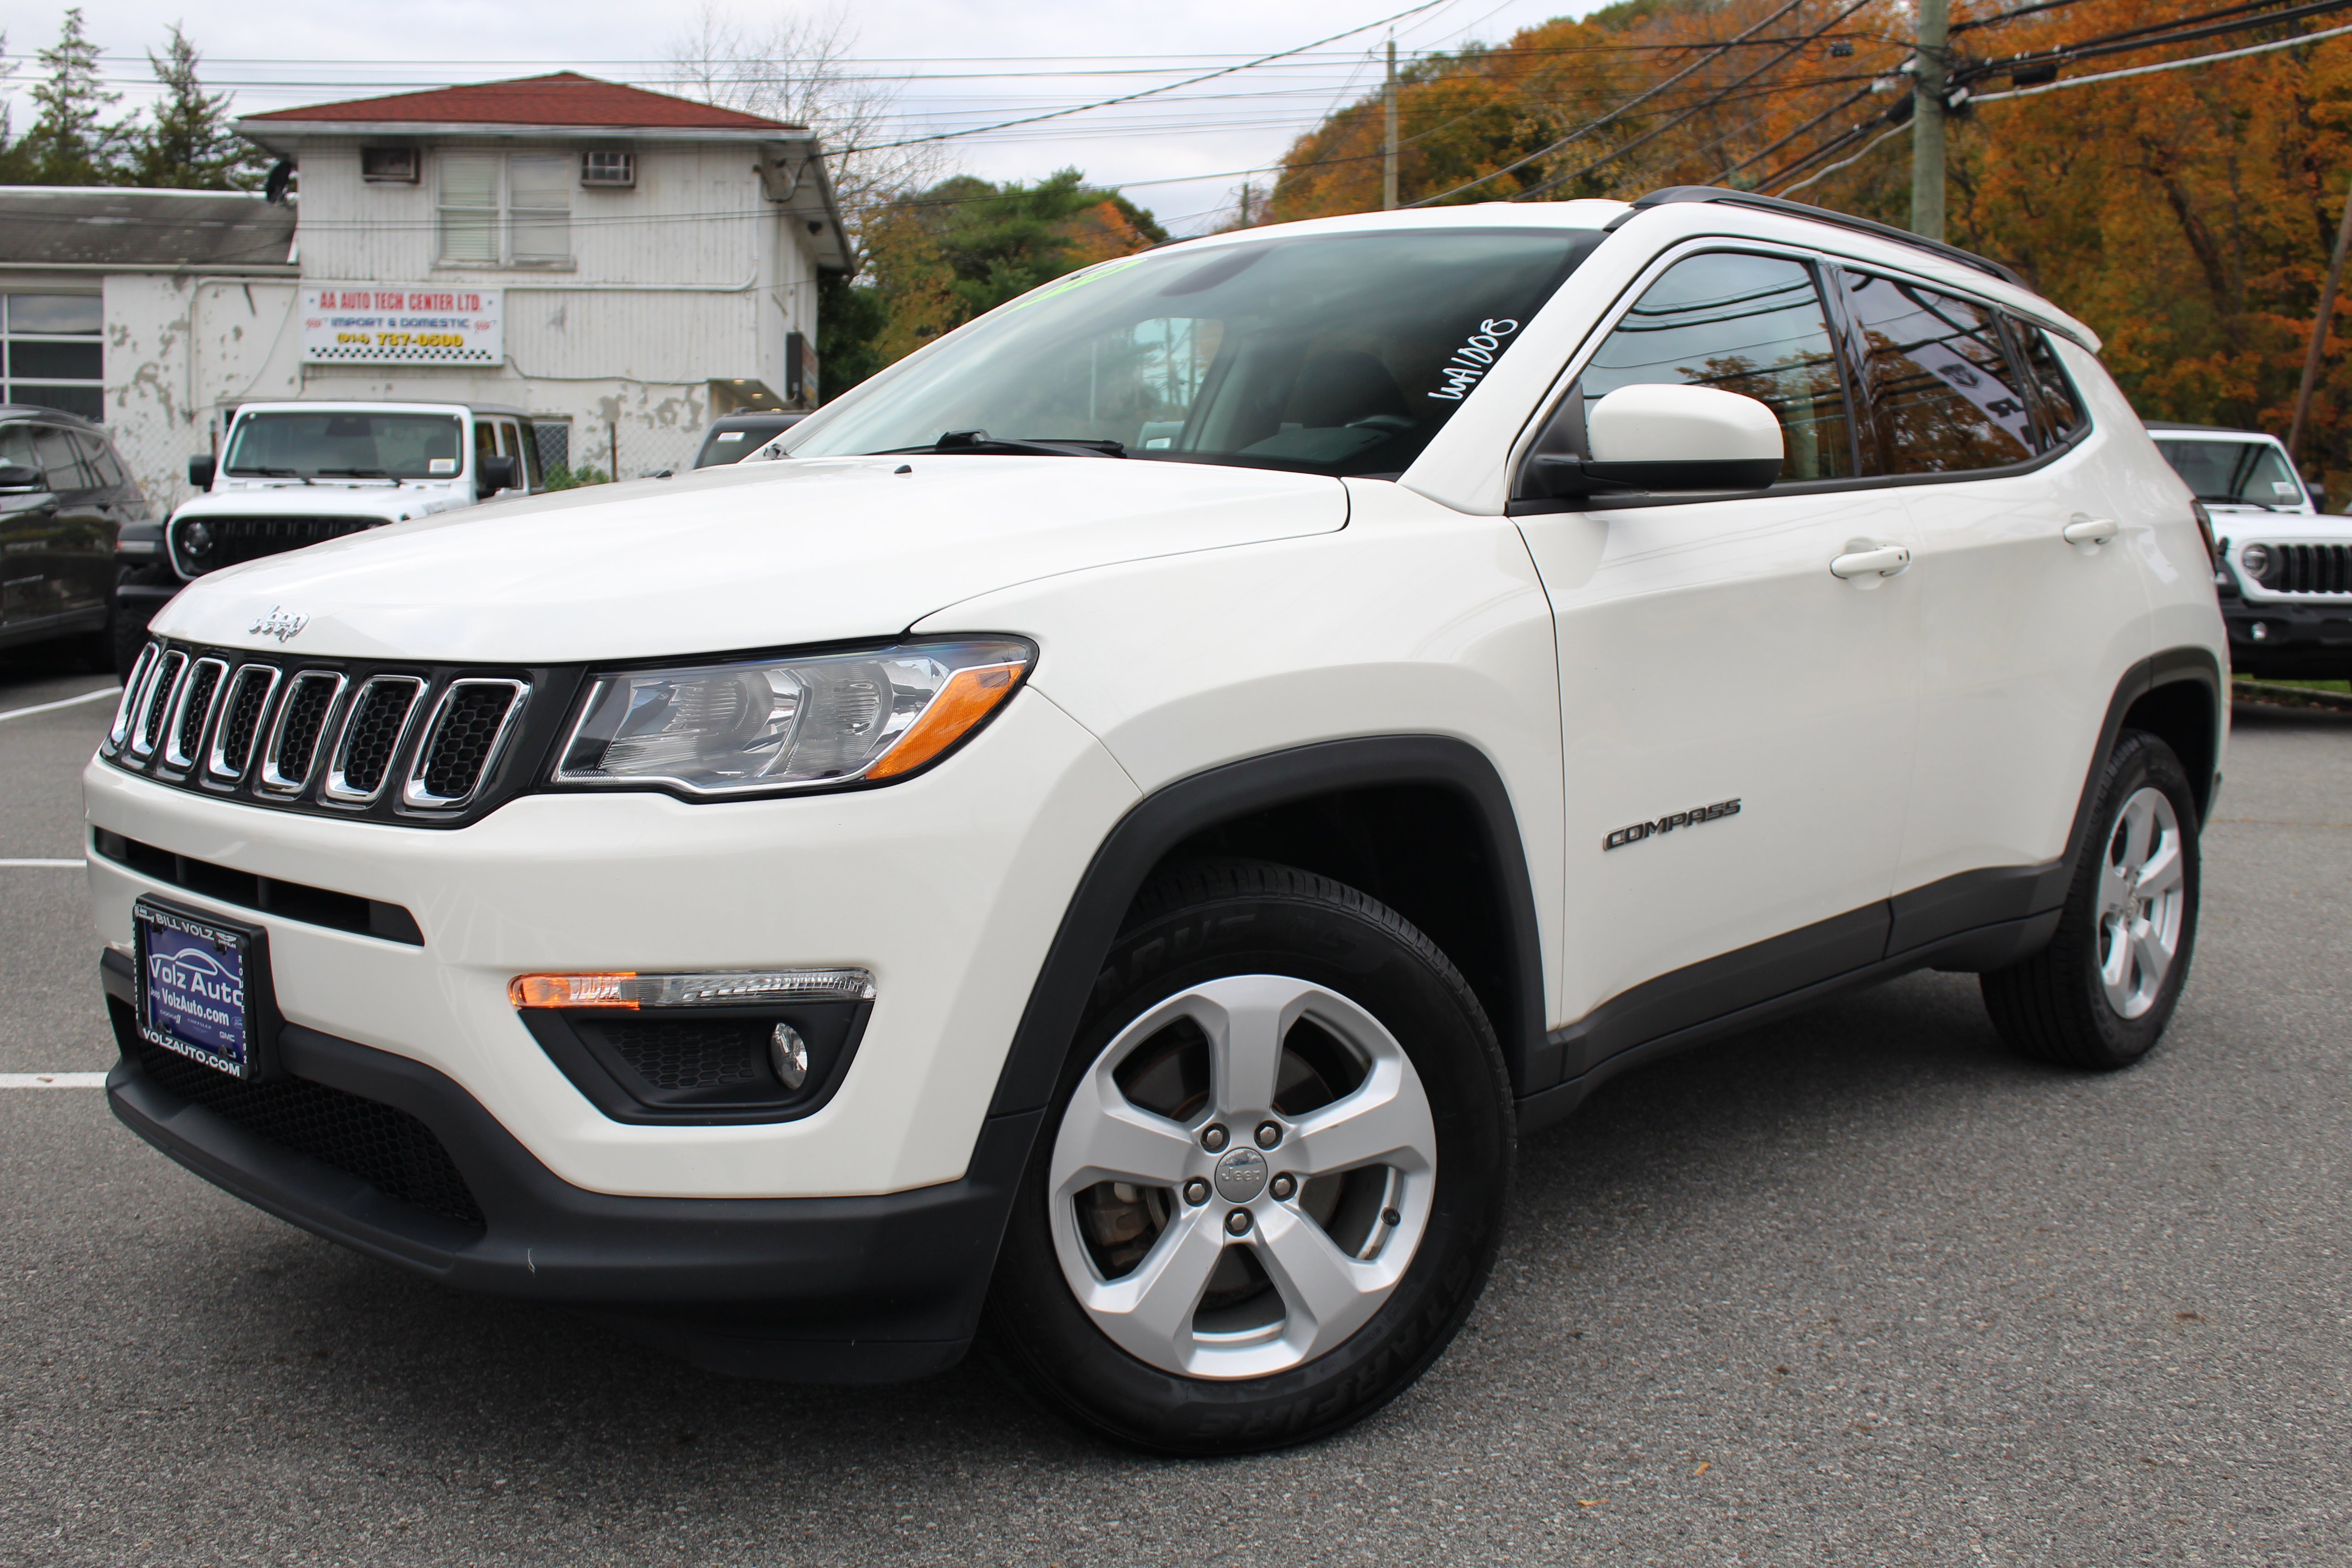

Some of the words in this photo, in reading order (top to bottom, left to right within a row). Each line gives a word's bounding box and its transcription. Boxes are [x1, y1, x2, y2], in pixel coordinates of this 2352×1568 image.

[320, 292, 337, 308] AA
[341, 292, 370, 309] AUTO
[374, 293, 403, 309] TECH
[410, 293, 453, 310] CENTER
[330, 317, 383, 327] IMPORT
[388, 318, 396, 327] &
[399, 318, 469, 328] DOMESTIC
[337, 333, 370, 345] (914)
[248, 604, 310, 643] Jeep
[1602, 796, 1741, 851] COMPASS
[155, 913, 181, 931] BILL
[181, 921, 215, 941] VOLZ
[149, 955, 187, 990] Volz
[190, 971, 243, 1007] Auto
[162, 987, 230, 1026] VolzAuto.com
[188, 1018, 212, 1029] CHRYSLER
[220, 1031, 235, 1042] GMC
[143, 1028, 240, 1077] VOLZAUTO.COM
[1220, 1166, 1260, 1184] Jeep
